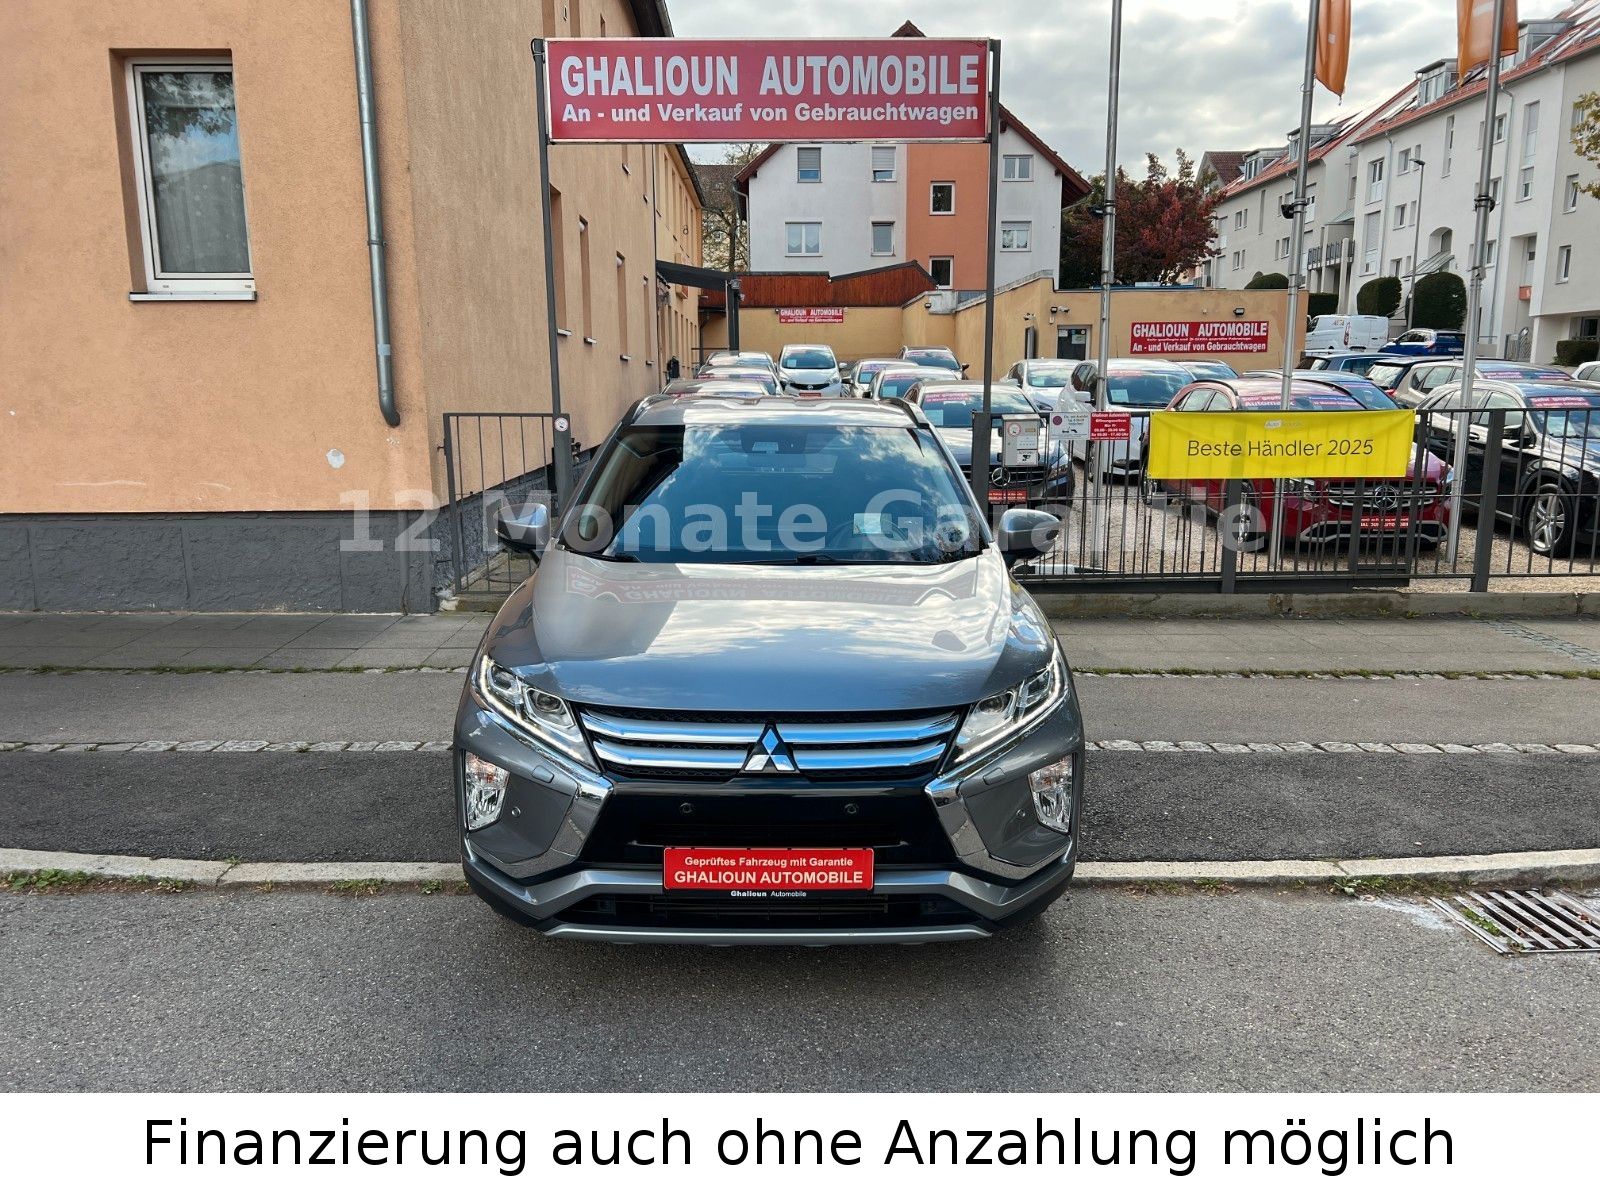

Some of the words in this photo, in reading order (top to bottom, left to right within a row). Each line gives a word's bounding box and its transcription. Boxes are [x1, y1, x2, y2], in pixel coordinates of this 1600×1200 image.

[560, 55, 738, 96] GHALIOUN
[759, 55, 979, 96] AUTOMOBILE
[562, 103, 591, 122] An
[611, 103, 650, 122] und
[657, 103, 743, 122] Verkauf
[750, 106, 787, 121] von
[794, 103, 978, 125] Gebrauchtwagen
[1133, 323, 1189, 338] GHALIOUN
[1197, 322, 1267, 337] AUTOMOBILE
[1132, 343, 1143, 352] An
[1148, 343, 1161, 352] und
[1163, 342, 1191, 352] Verkauf
[1193, 343, 1205, 351] von
[1206, 341, 1266, 353] Gebrauchtwagen
[1187, 440, 1242, 457] Beste
[1248, 439, 1322, 457] Händler
[1327, 439, 1374, 456] 2025
[684, 856, 736, 868] Geprüftes
[739, 856, 787, 868] Fahrzeug
[790, 857, 807, 867] mit
[809, 857, 854, 867] Garantie
[674, 871, 757, 884] GHALIOUN
[760, 871, 863, 884] AUTOMOBILE
